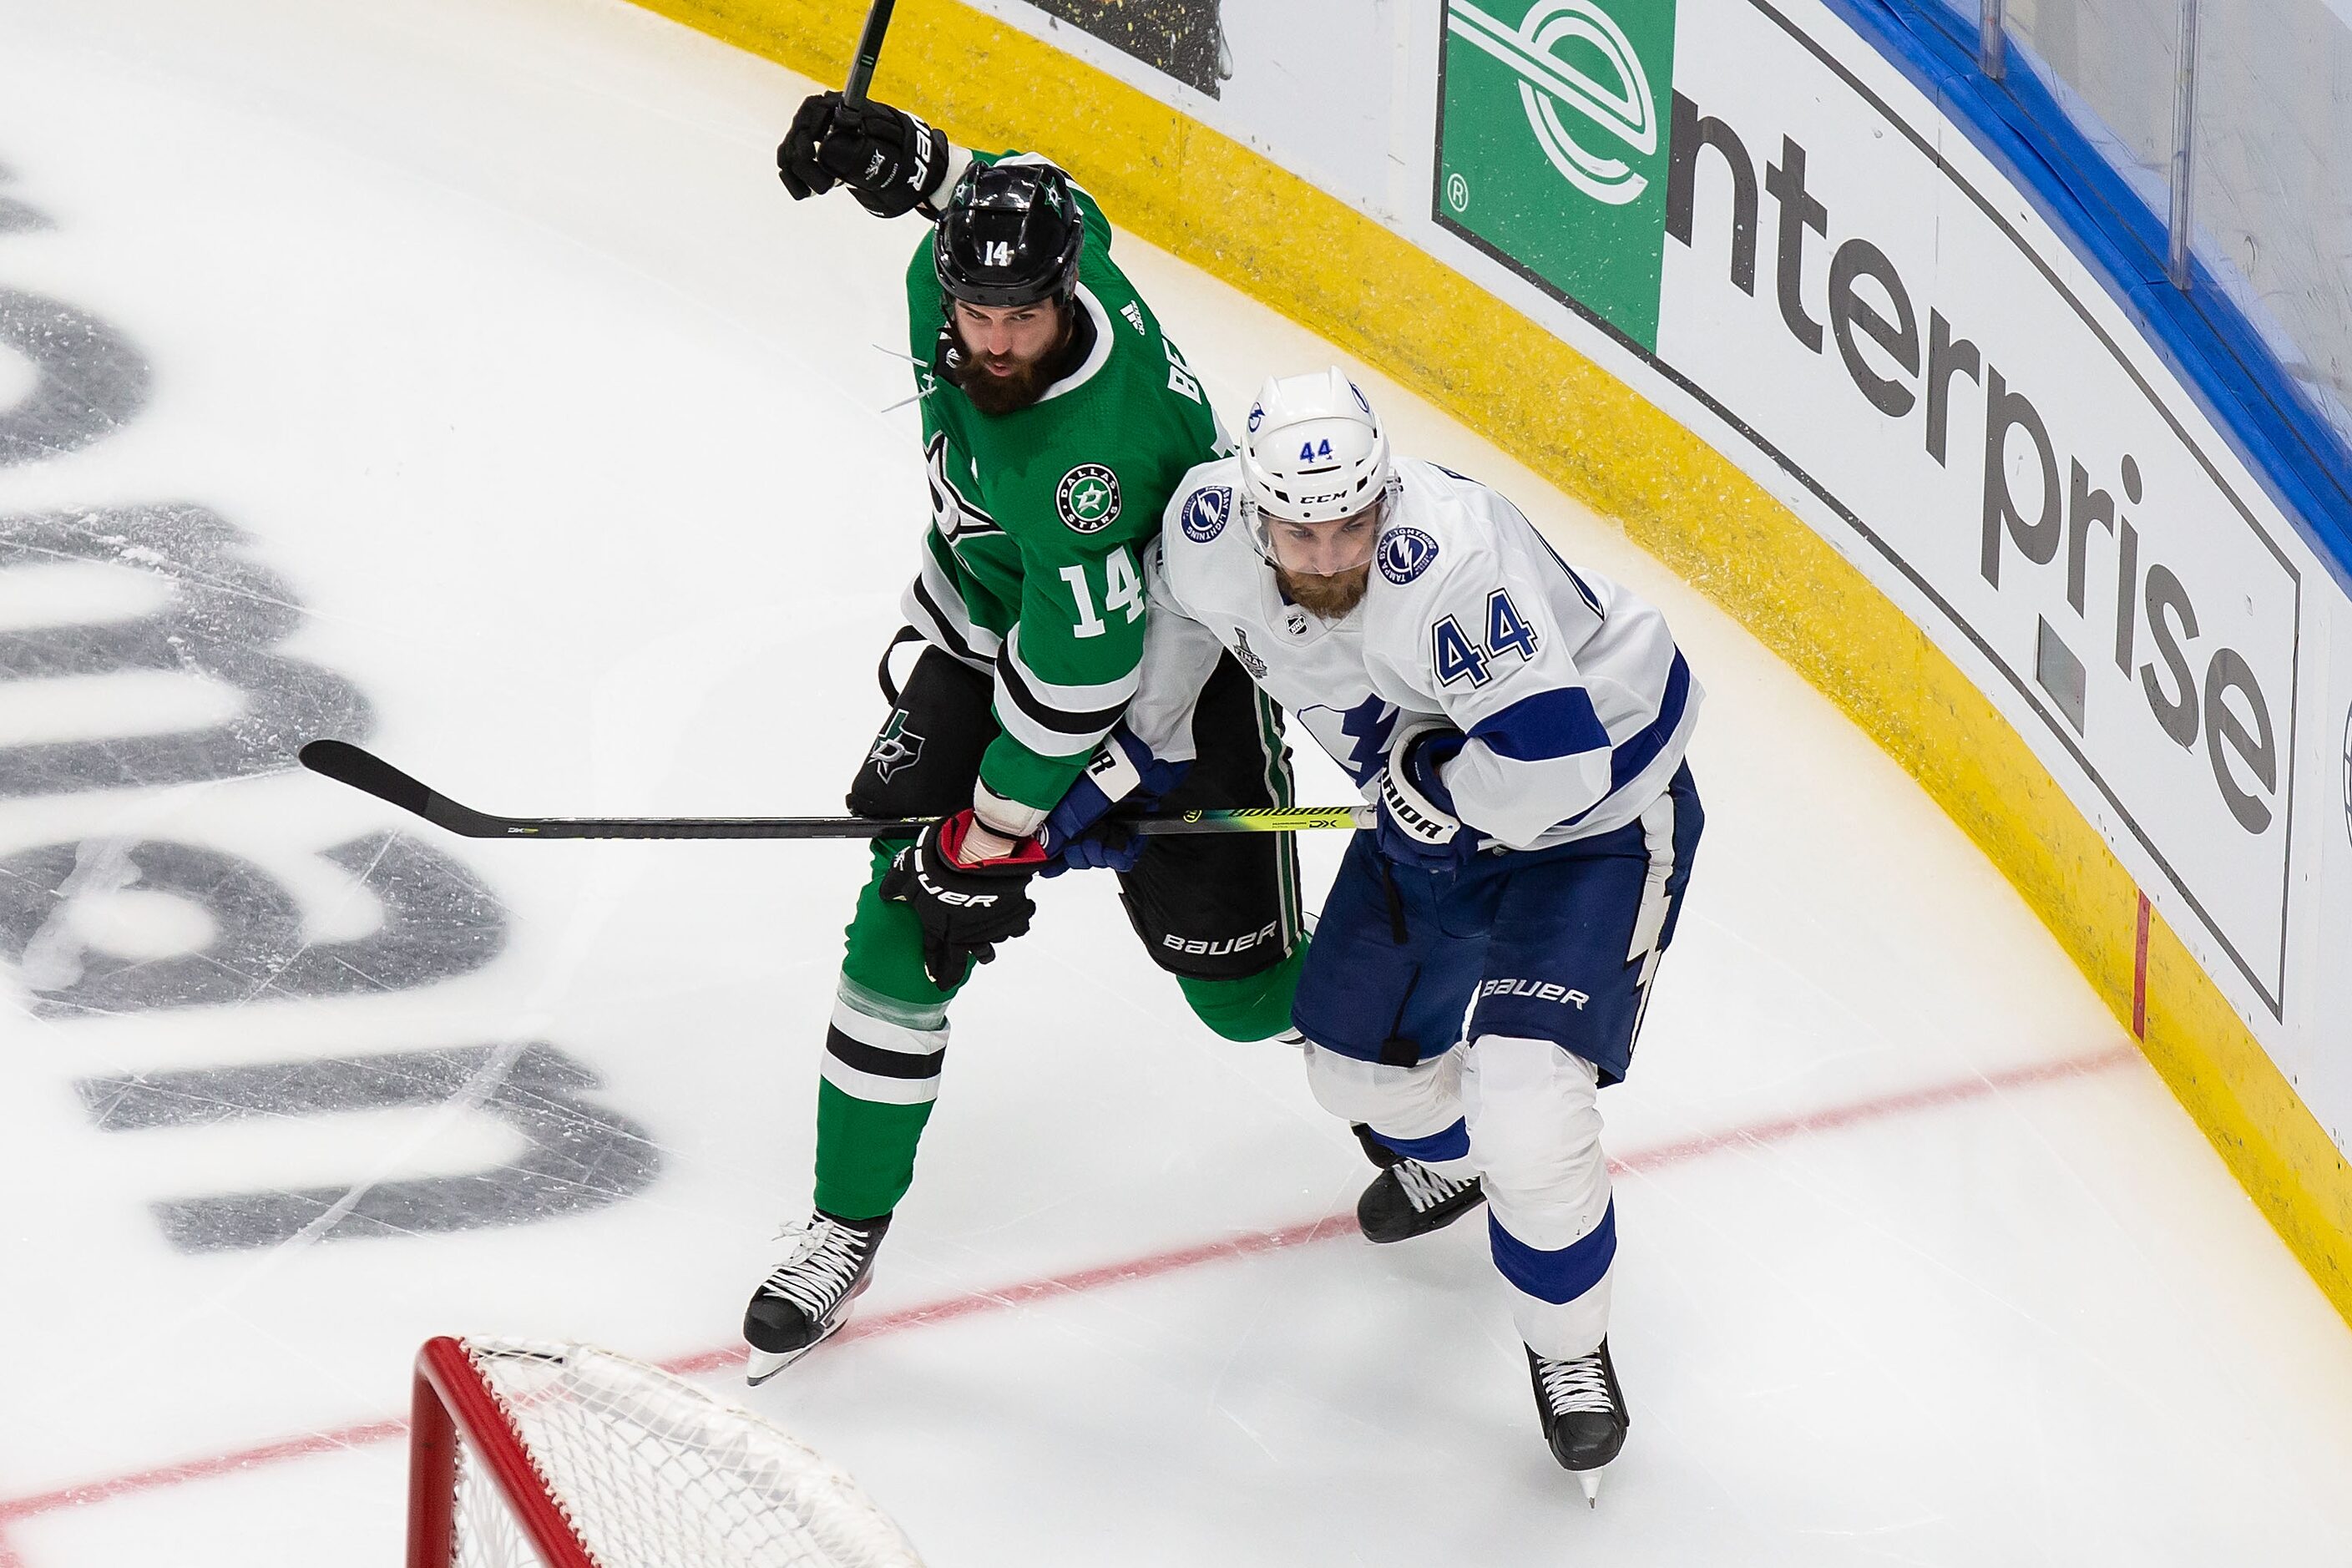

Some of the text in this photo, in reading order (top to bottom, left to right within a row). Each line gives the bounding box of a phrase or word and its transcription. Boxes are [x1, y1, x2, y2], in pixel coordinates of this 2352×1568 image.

[985, 241, 1009, 266] 14
[1300, 438, 1333, 463] 44
[1060, 468, 1116, 498] DALLAS
[1300, 489, 1348, 504] CCM
[1066, 506, 1118, 529] STARS
[1381, 561, 1406, 583] TAMPA
[1059, 545, 1146, 639] 14
[1431, 587, 1538, 689] 44
